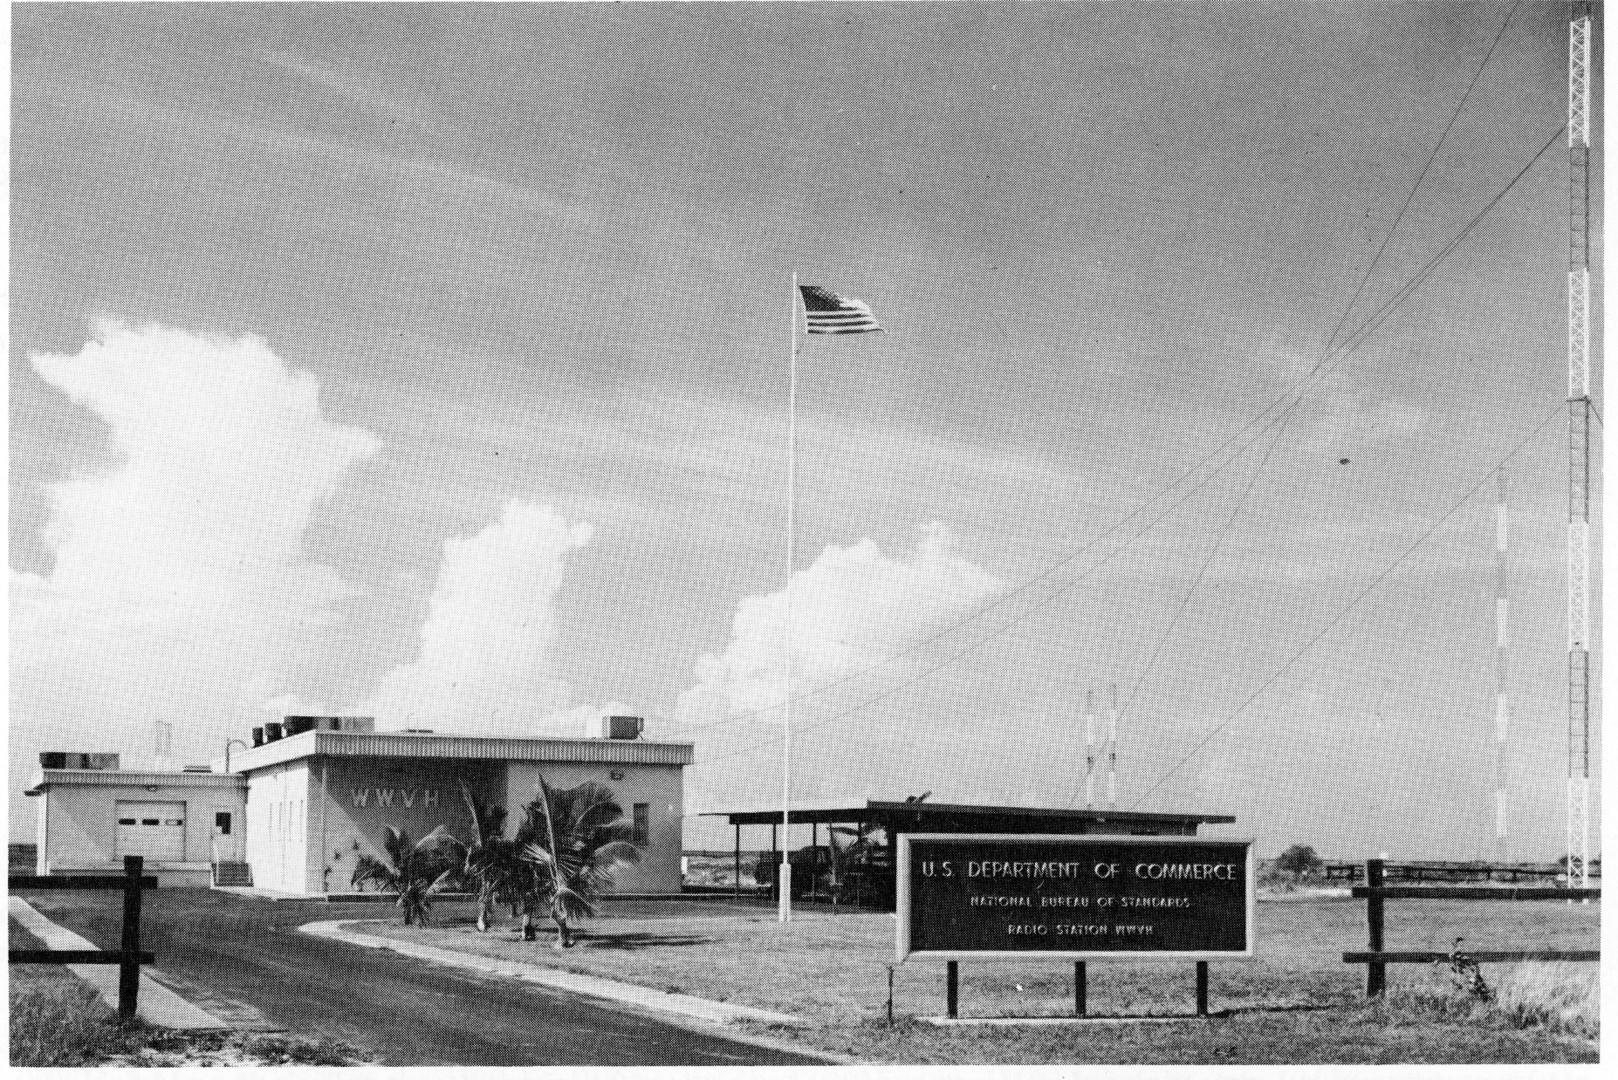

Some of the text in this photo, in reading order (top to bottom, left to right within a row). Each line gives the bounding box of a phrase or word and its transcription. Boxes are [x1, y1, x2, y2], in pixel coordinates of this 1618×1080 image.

[352, 789, 438, 808] WWVH
[968, 861, 1080, 879] DEPARTMENT
[1094, 862, 1121, 879] OF
[1136, 863, 1238, 881] COMMERCE
[970, 896, 1190, 908] NATIONAL BUREAU OF STANDARDS
[1008, 924, 1154, 936] RADIO STATION WWVH
